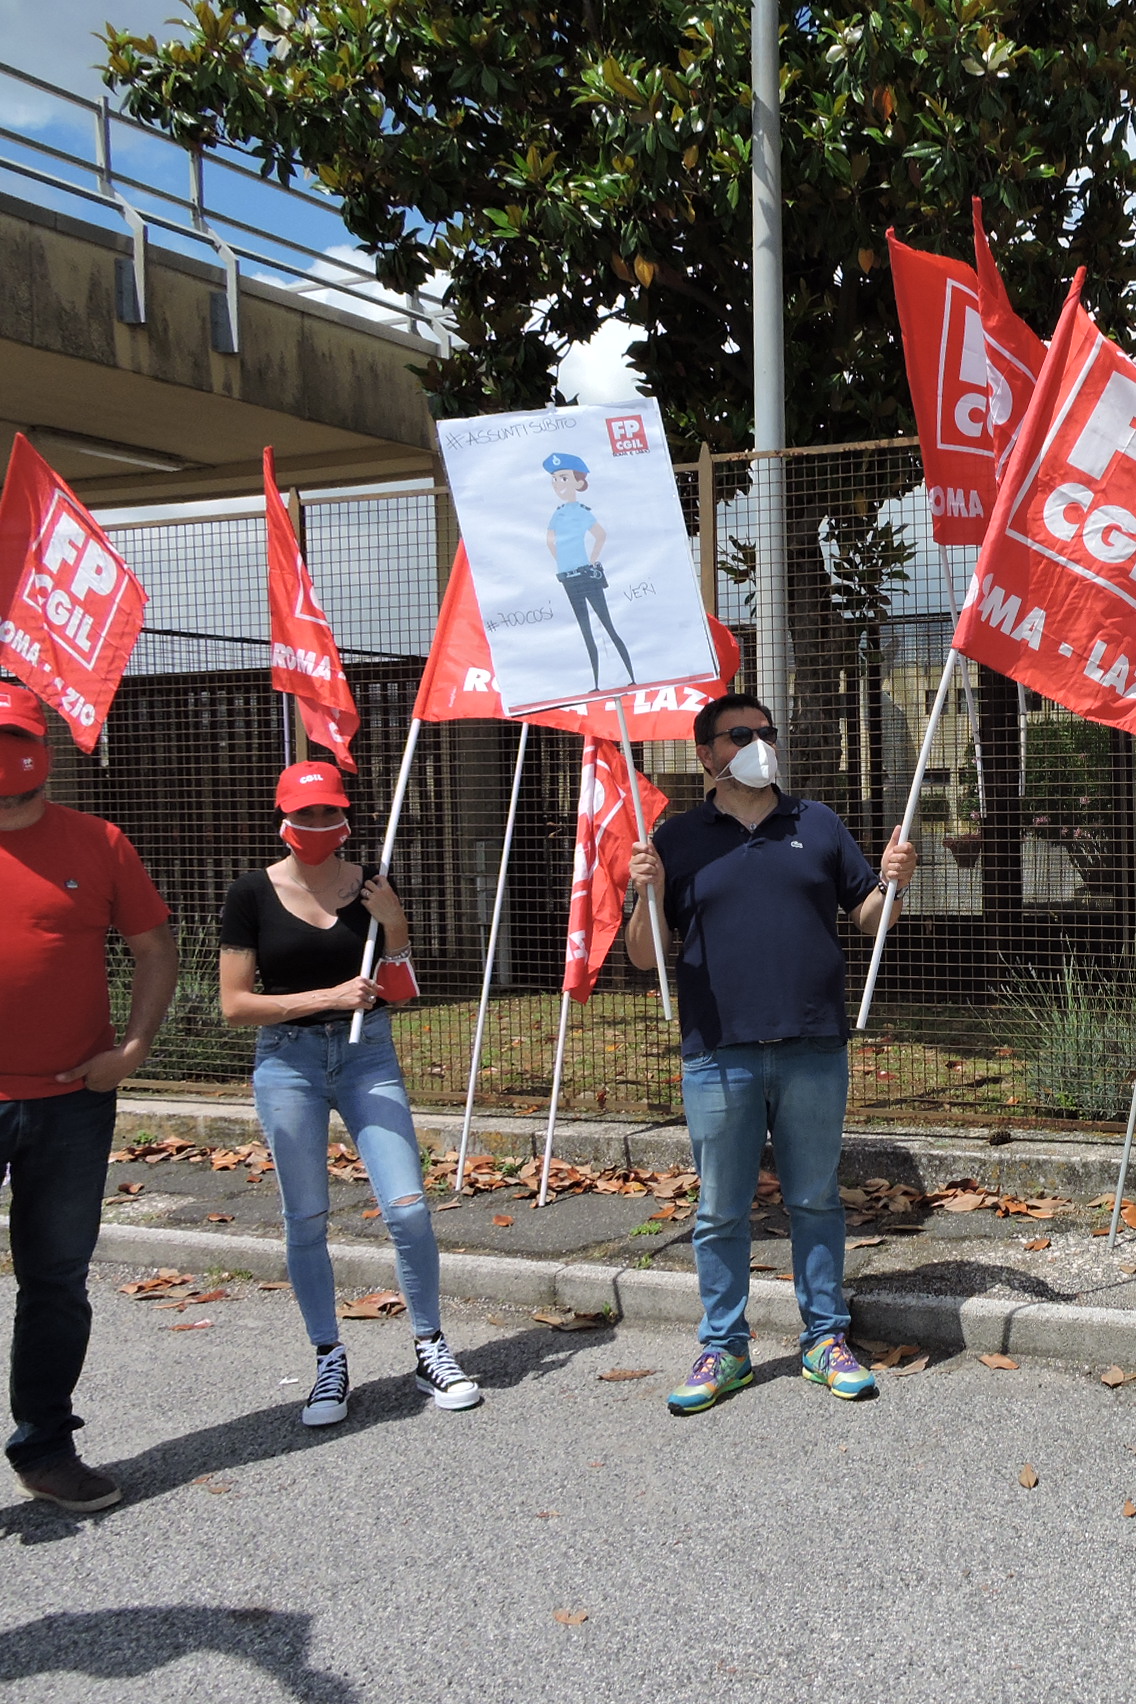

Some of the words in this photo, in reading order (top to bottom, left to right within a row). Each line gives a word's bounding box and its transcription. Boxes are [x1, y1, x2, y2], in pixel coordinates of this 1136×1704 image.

[611, 420, 640, 439] FP
[616, 439, 643, 450] CGIL
[928, 485, 984, 518] OMA
[43, 512, 117, 601] FP
[622, 582, 656, 602] VERI
[0, 617, 41, 667] OMA
[272, 642, 331, 681] ROMA
[634, 686, 715, 714] LAZ
